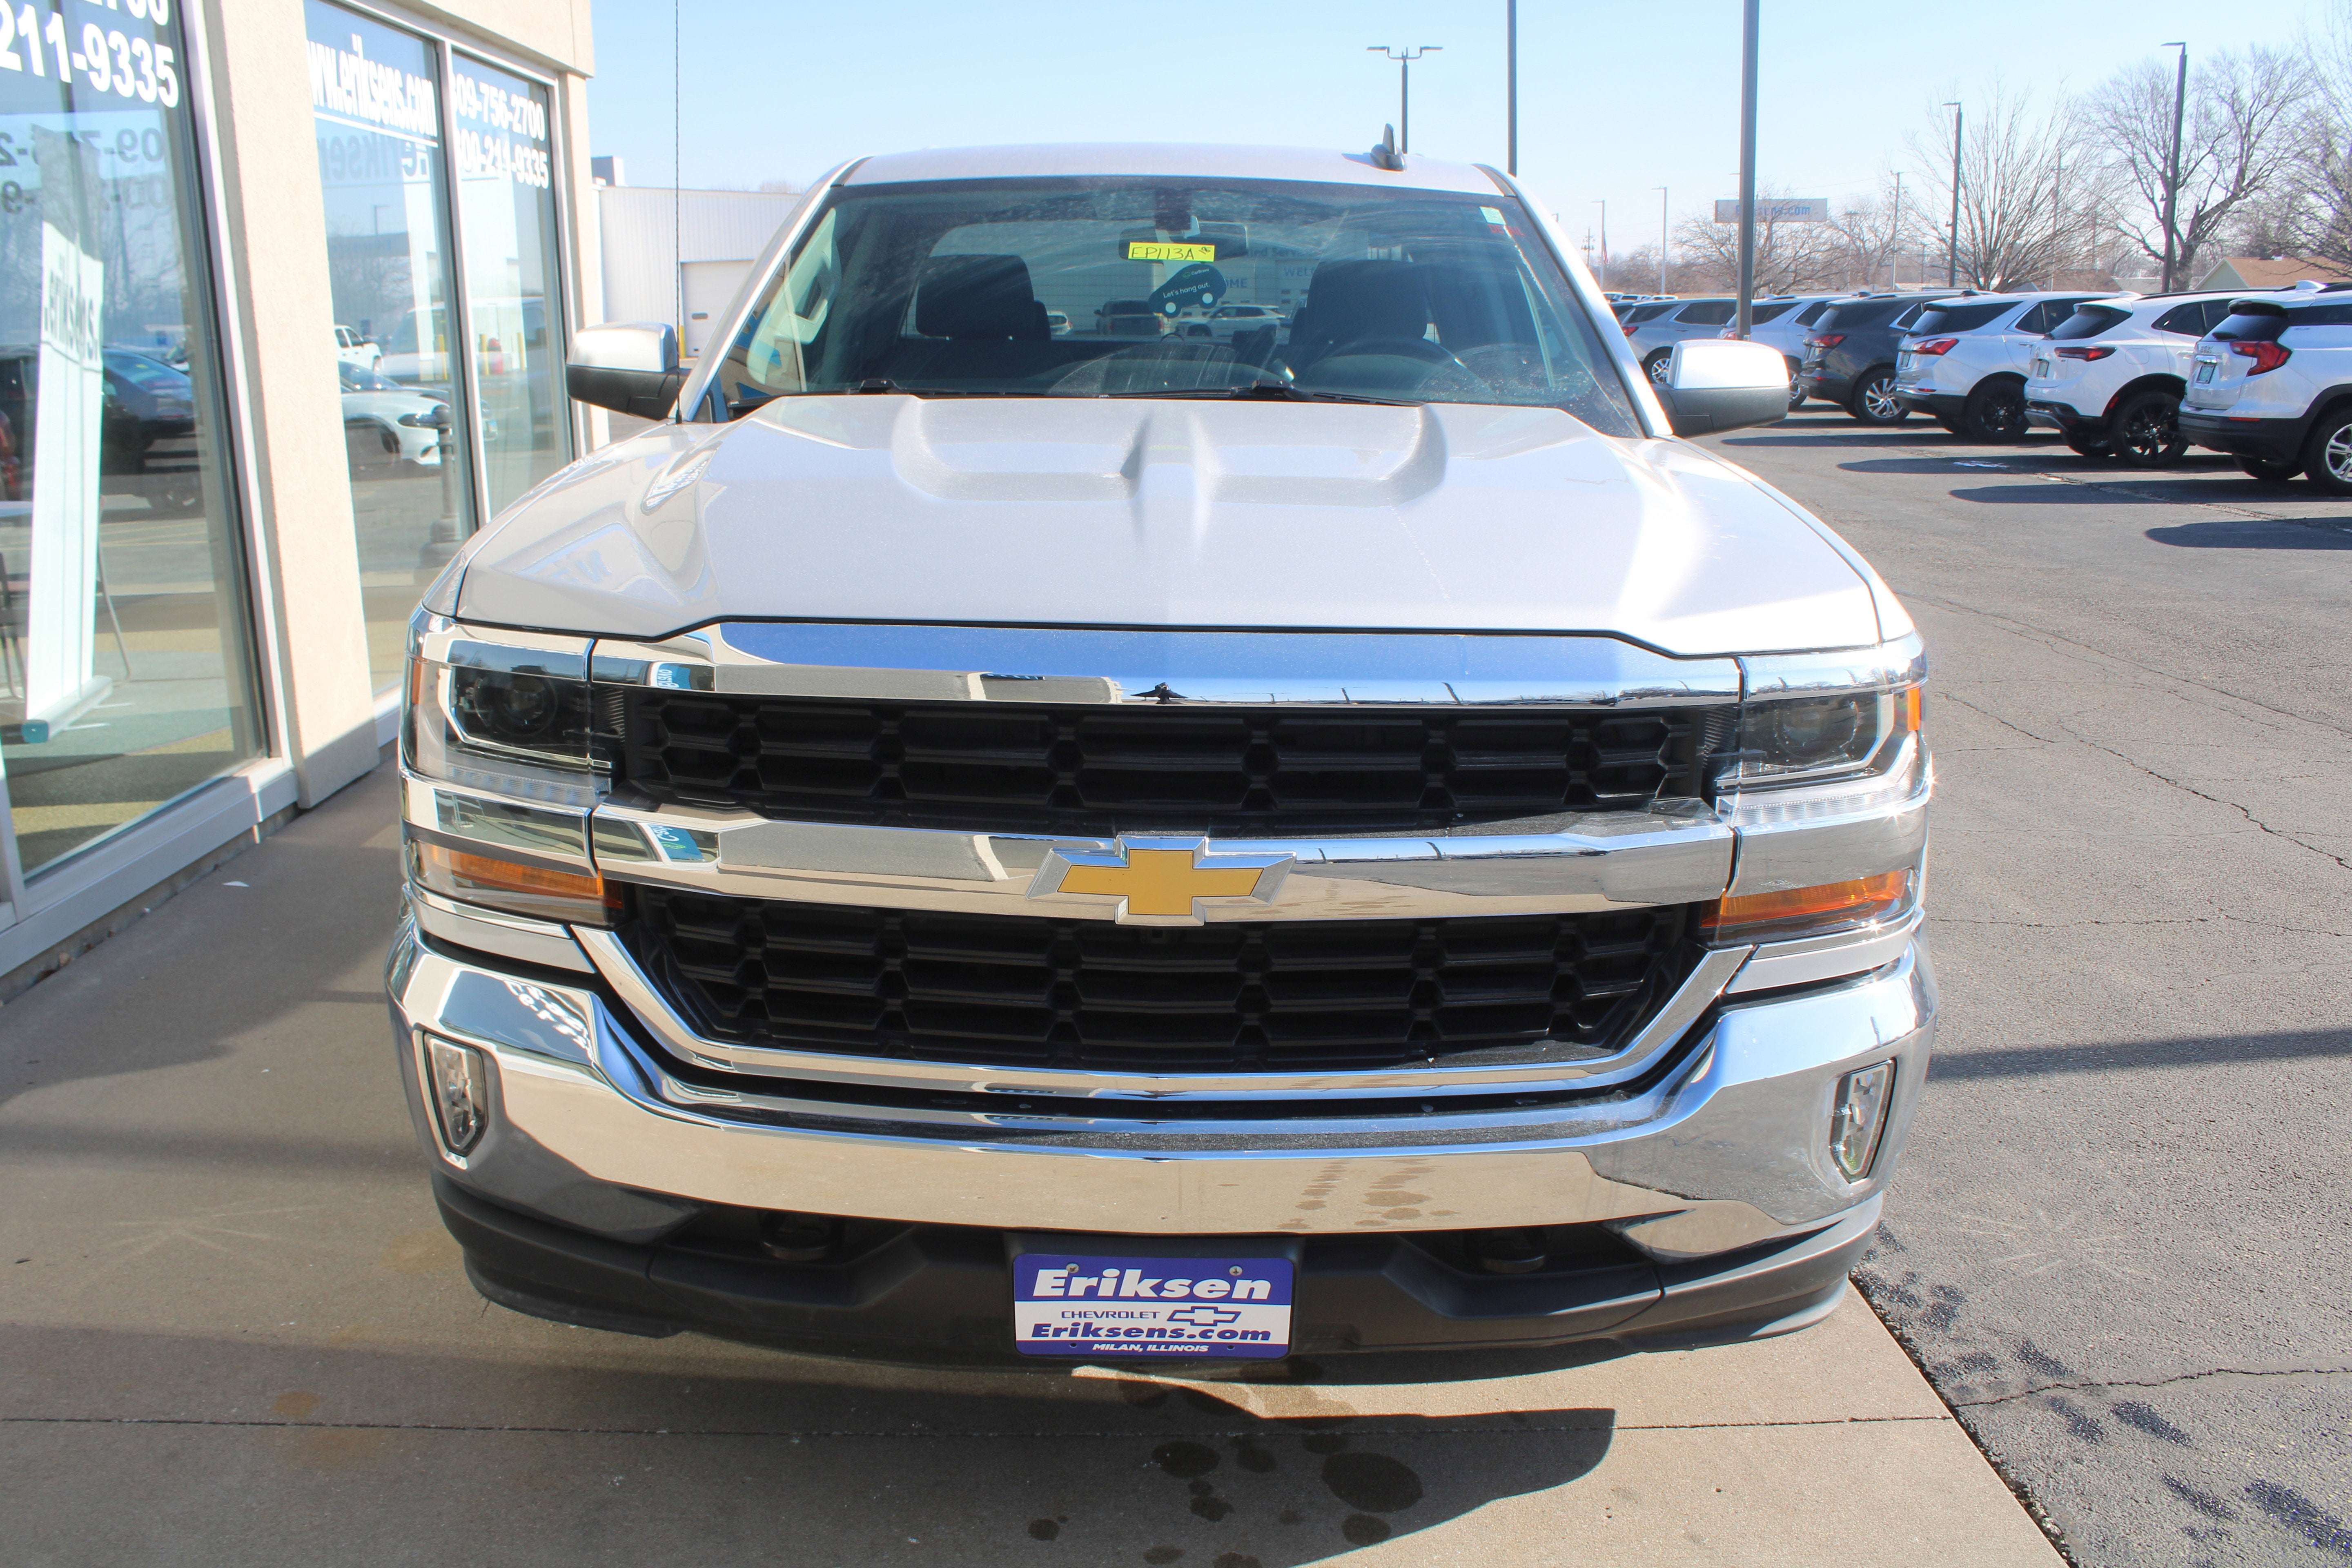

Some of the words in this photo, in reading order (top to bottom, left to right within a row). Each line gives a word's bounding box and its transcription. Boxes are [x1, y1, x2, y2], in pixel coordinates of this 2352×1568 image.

[1131, 247, 1194, 260] EP113A
[1163, 290, 1178, 298] Let's
[1033, 1267, 1272, 1300] Eriksen
[1061, 1310, 1160, 1319] CHEVROLET
[1031, 1322, 1271, 1341] Eriksens.com
[1092, 1342, 1144, 1352] MILAN,
[1146, 1344, 1209, 1352] ILLINOIS
